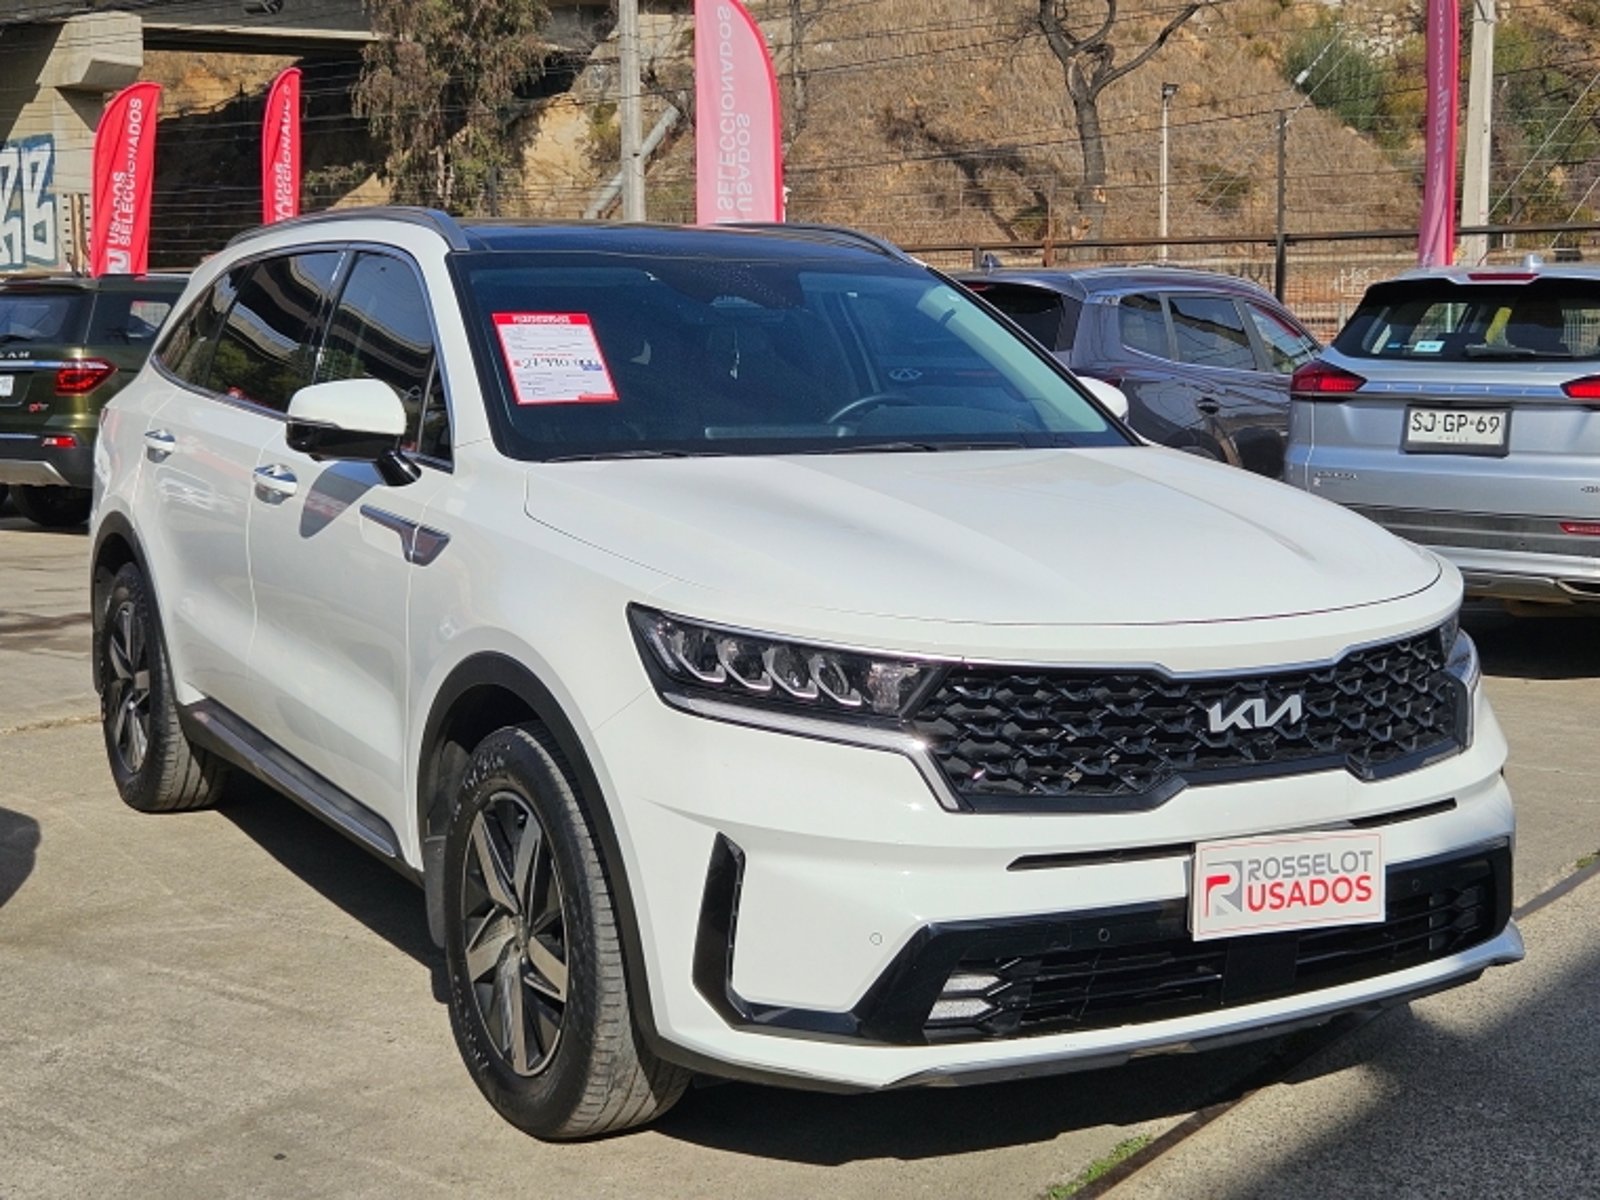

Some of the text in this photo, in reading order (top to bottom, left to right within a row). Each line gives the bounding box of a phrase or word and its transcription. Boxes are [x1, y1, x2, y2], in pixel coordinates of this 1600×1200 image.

[118, 97, 143, 247] SELECCIONADOS
[107, 170, 128, 245] USADOS
[1207, 693, 1303, 734] KIA
[1247, 850, 1373, 882] ROSSELOT
[1247, 874, 1373, 913] USADOS
